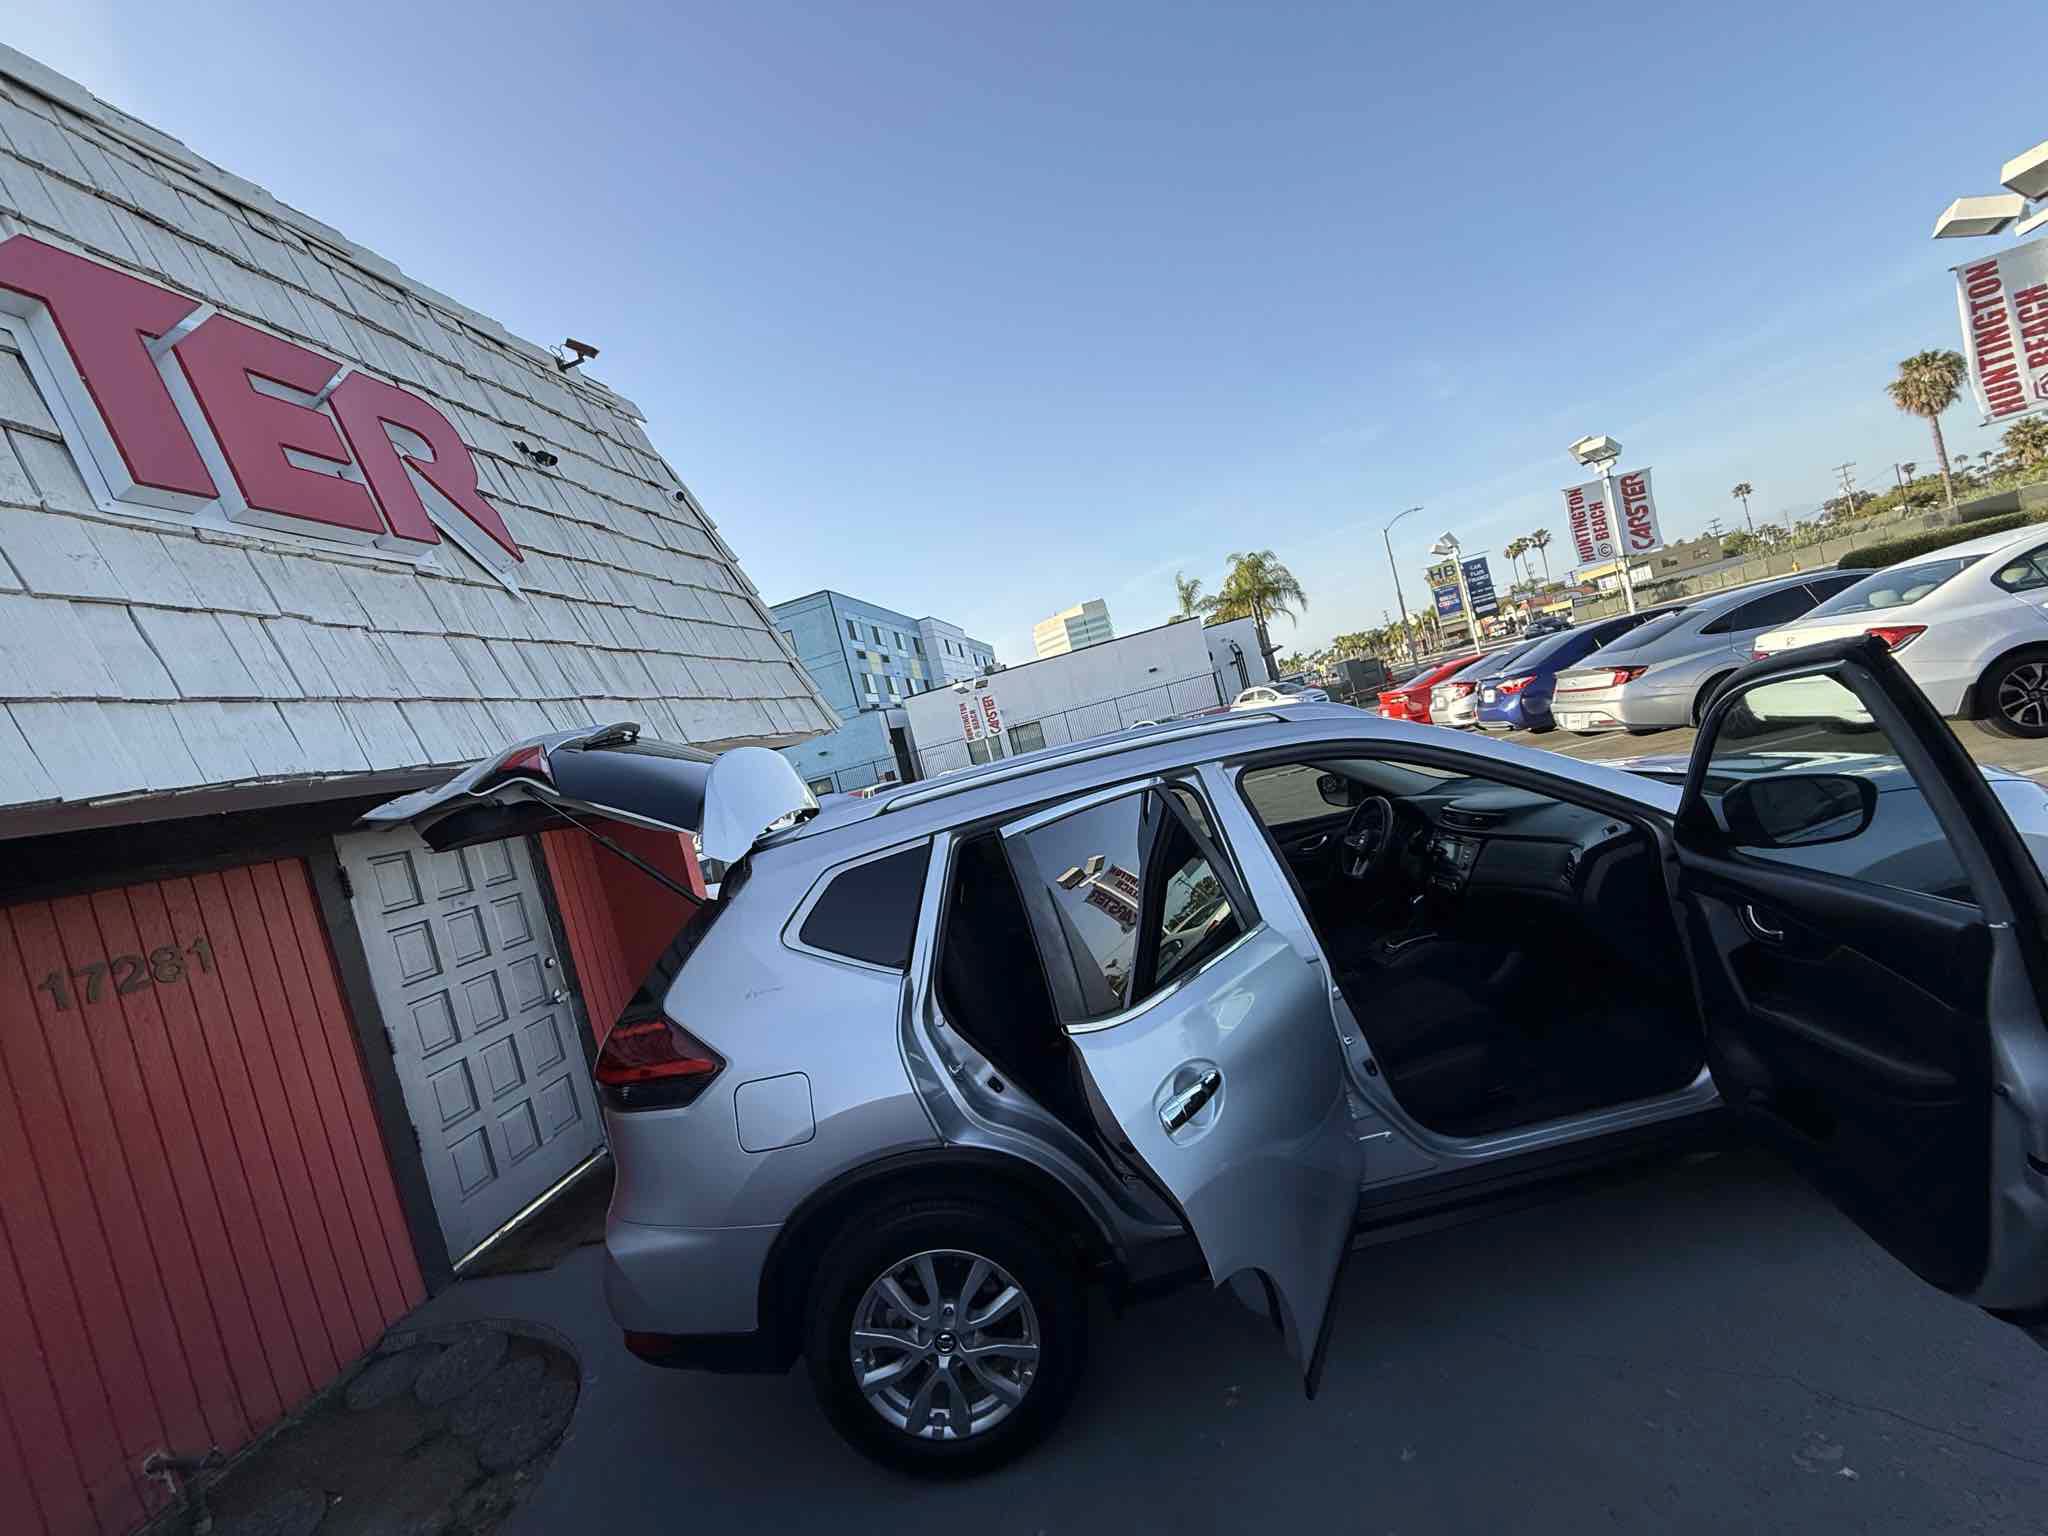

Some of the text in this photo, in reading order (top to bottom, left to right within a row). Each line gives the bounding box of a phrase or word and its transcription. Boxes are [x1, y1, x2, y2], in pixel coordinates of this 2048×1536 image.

[1965, 259, 2027, 417] HUNTINGTON
[2014, 283, 2048, 369] BEACH
[0, 233, 524, 563] TER
[1567, 487, 1596, 562] HUNTINGTON
[1588, 501, 1610, 541] BEACH
[1620, 471, 1656, 550] CARSTER
[38, 935, 212, 1012] 17281
